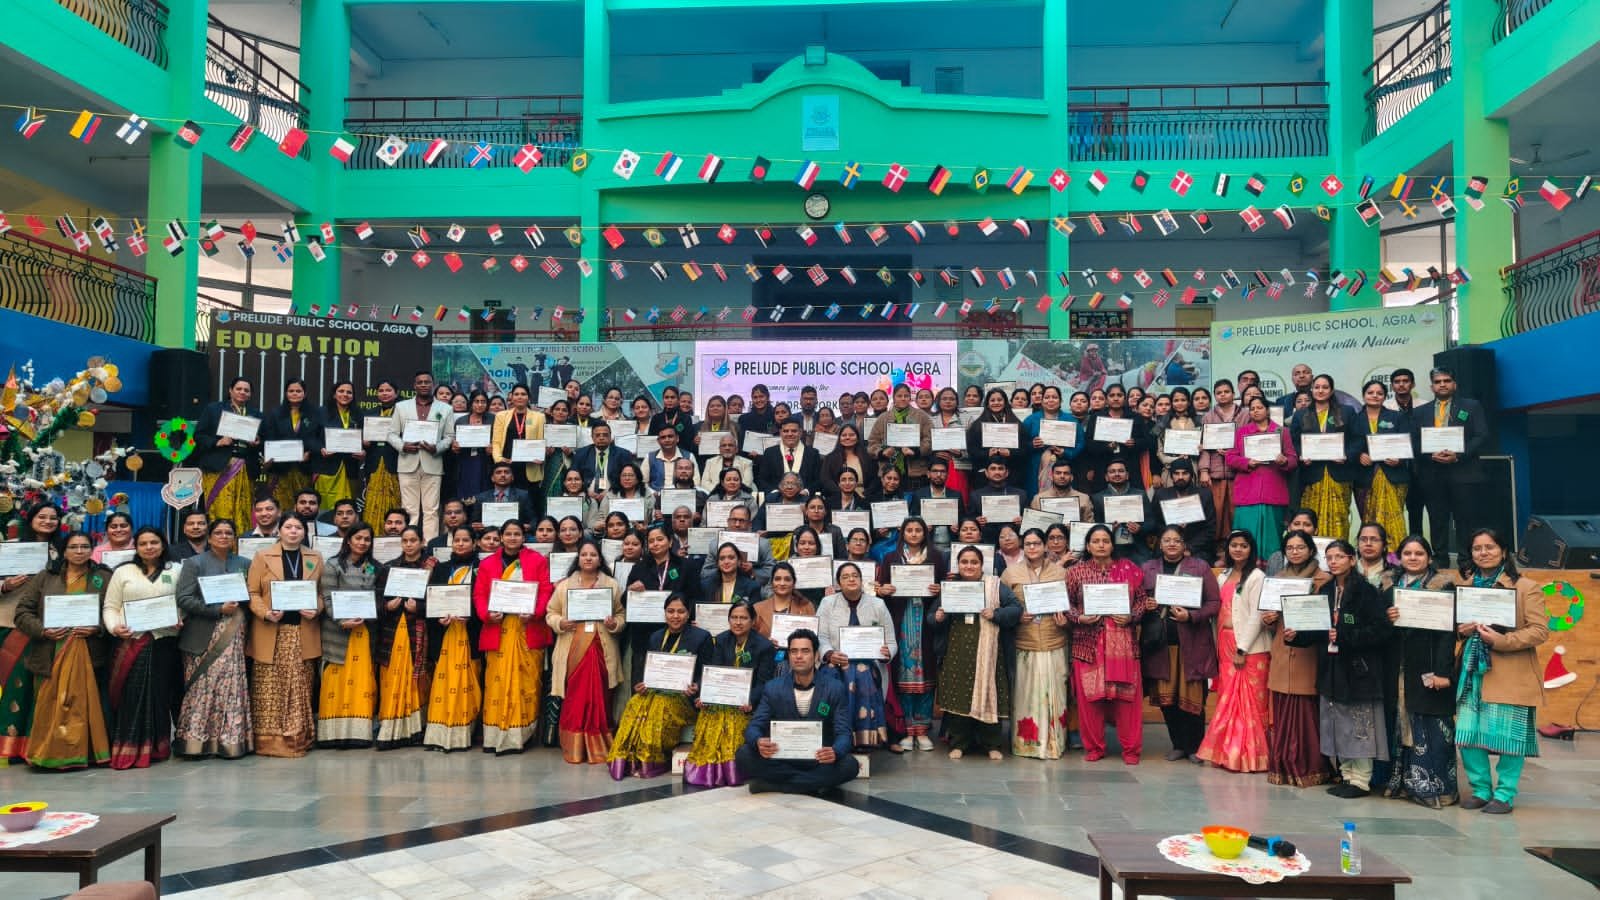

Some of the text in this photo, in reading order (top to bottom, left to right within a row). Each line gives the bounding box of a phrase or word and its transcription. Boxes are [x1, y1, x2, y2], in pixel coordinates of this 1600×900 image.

[233, 312, 413, 335] PRELUDE PUBLIC SCHOOL, AGRA
[1236, 313, 1417, 337] PRELUDE PUBLIC SCHOOL, AGRA
[216, 329, 380, 357] EDUCATION
[572, 345, 605, 353] SCHOOL
[1241, 335, 1410, 356] Always Greet with Nature
[734, 361, 788, 375] PRELUDE
[792, 361, 836, 375] PUBLIC
[903, 361, 941, 375] AGRA
